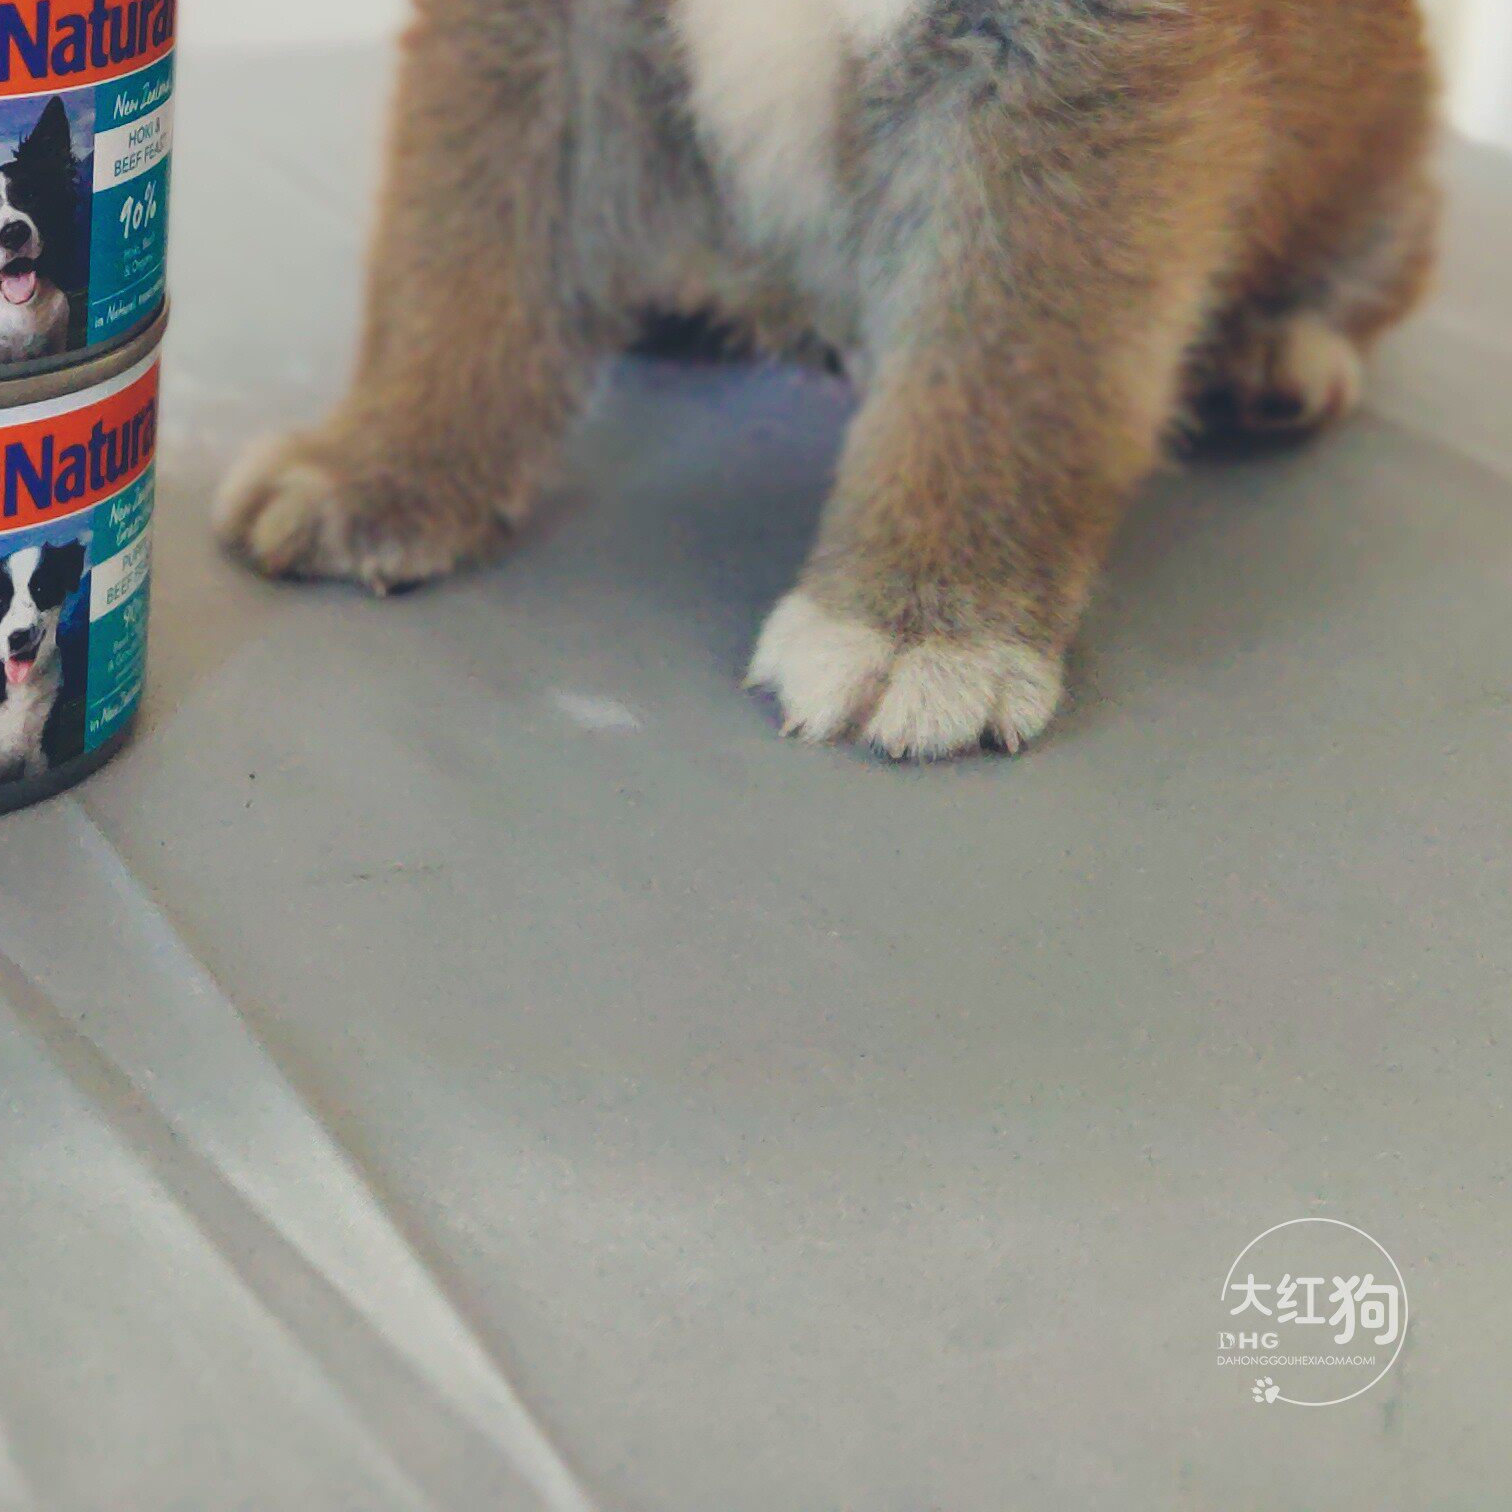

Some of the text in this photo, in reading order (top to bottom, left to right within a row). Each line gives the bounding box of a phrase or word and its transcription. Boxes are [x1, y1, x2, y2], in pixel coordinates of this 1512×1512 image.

[113, 91, 138, 120] New
[128, 124, 154, 150] HOKI
[113, 152, 142, 178] BEEF
[119, 180, 157, 239] 90%
[94, 311, 105, 329] in
